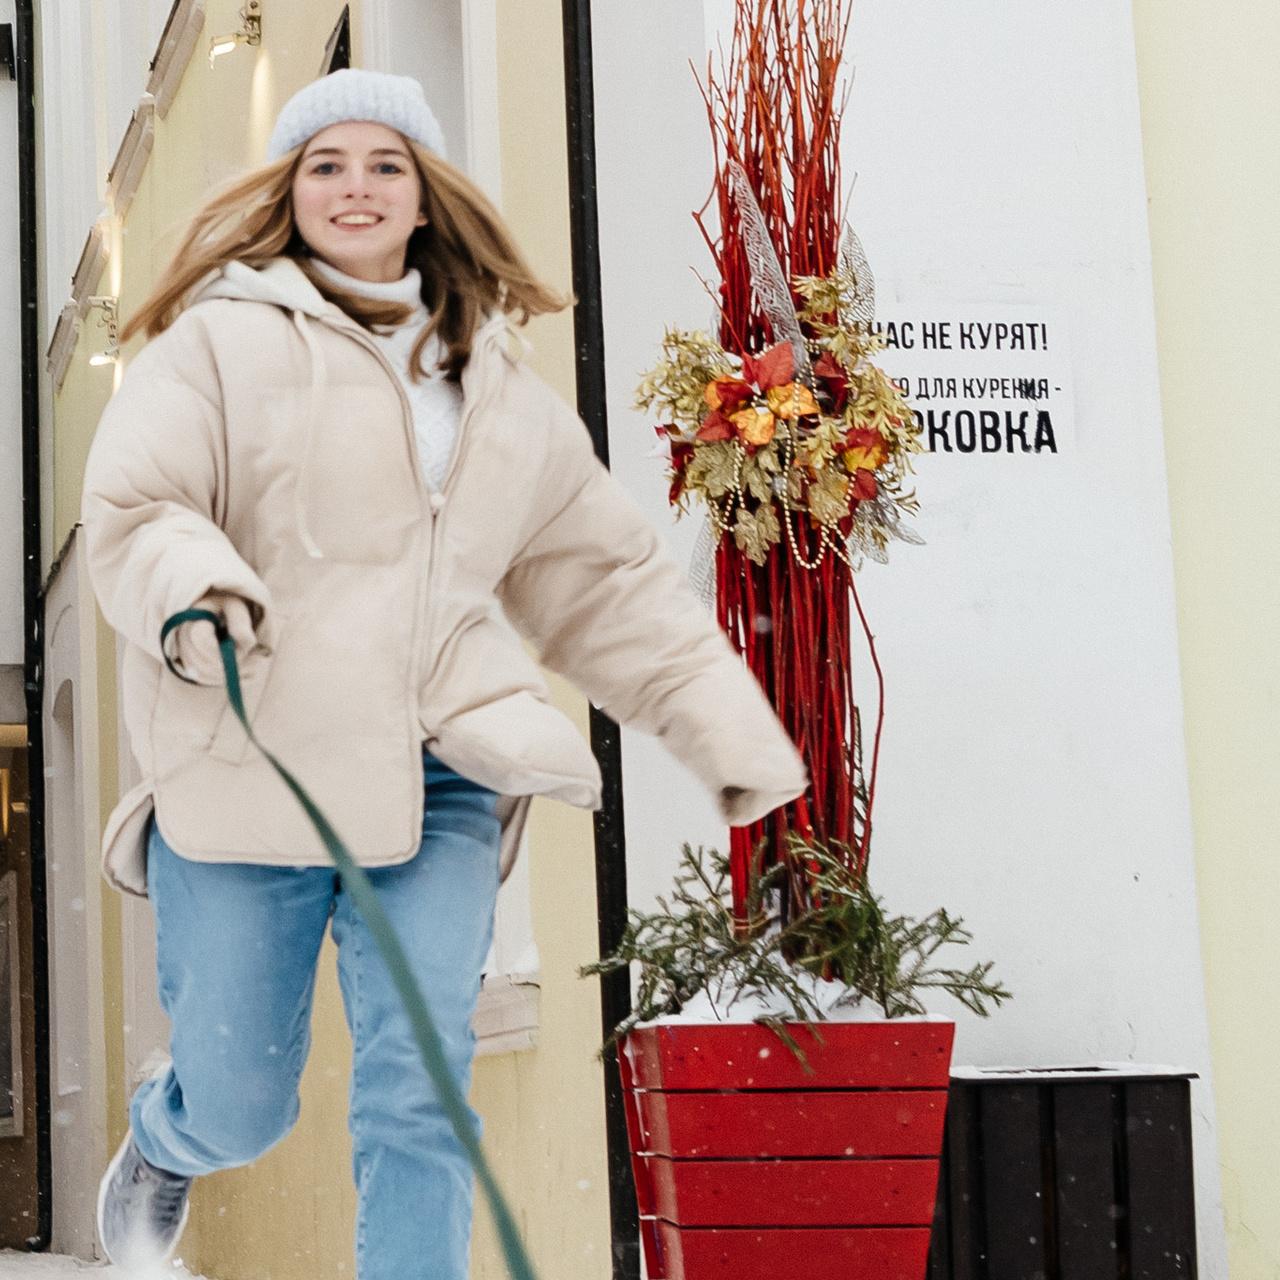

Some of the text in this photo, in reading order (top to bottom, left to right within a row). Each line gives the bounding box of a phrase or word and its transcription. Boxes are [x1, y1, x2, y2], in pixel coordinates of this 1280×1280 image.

[922, 322, 952, 350] НЕ
[959, 322, 1048, 351] КУРЯТ!
[915, 377, 957, 401] ДЛЯ
